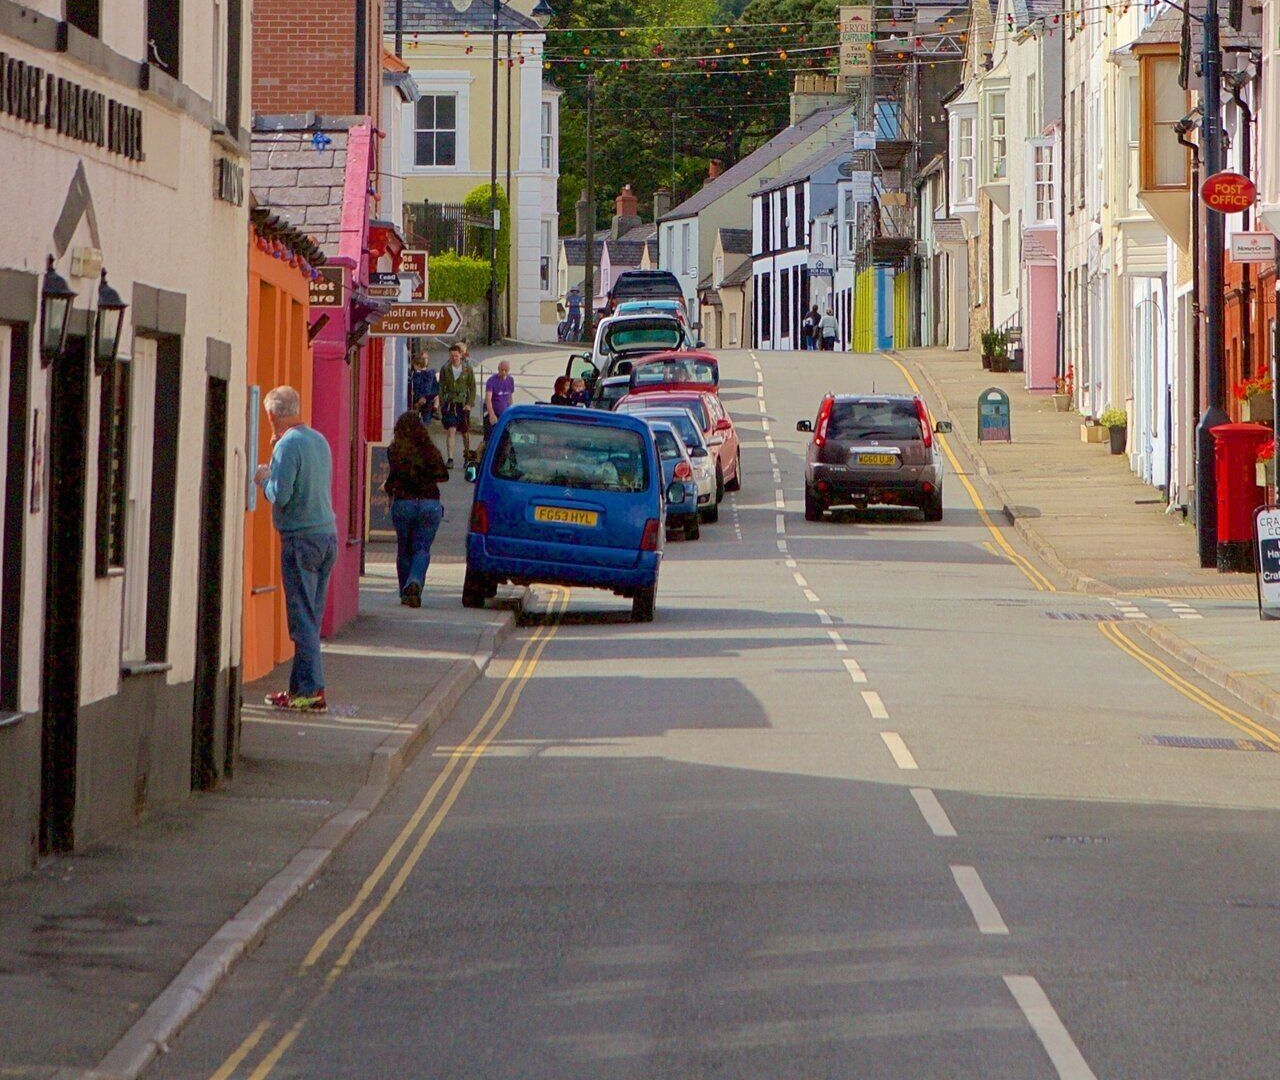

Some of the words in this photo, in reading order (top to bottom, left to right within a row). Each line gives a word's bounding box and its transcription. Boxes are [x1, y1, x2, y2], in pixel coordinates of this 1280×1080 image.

[1215, 184, 1244, 194] POST
[1210, 194, 1248, 206] OFFICE
[309, 281, 335, 291] ket
[309, 295, 335, 303] are
[384, 307, 418, 317] nolfan
[421, 307, 445, 318] Hwyl
[382, 321, 400, 330] Fun
[402, 321, 436, 331] Centre
[540, 508, 568, 521] FG53
[571, 511, 592, 524] HYL
